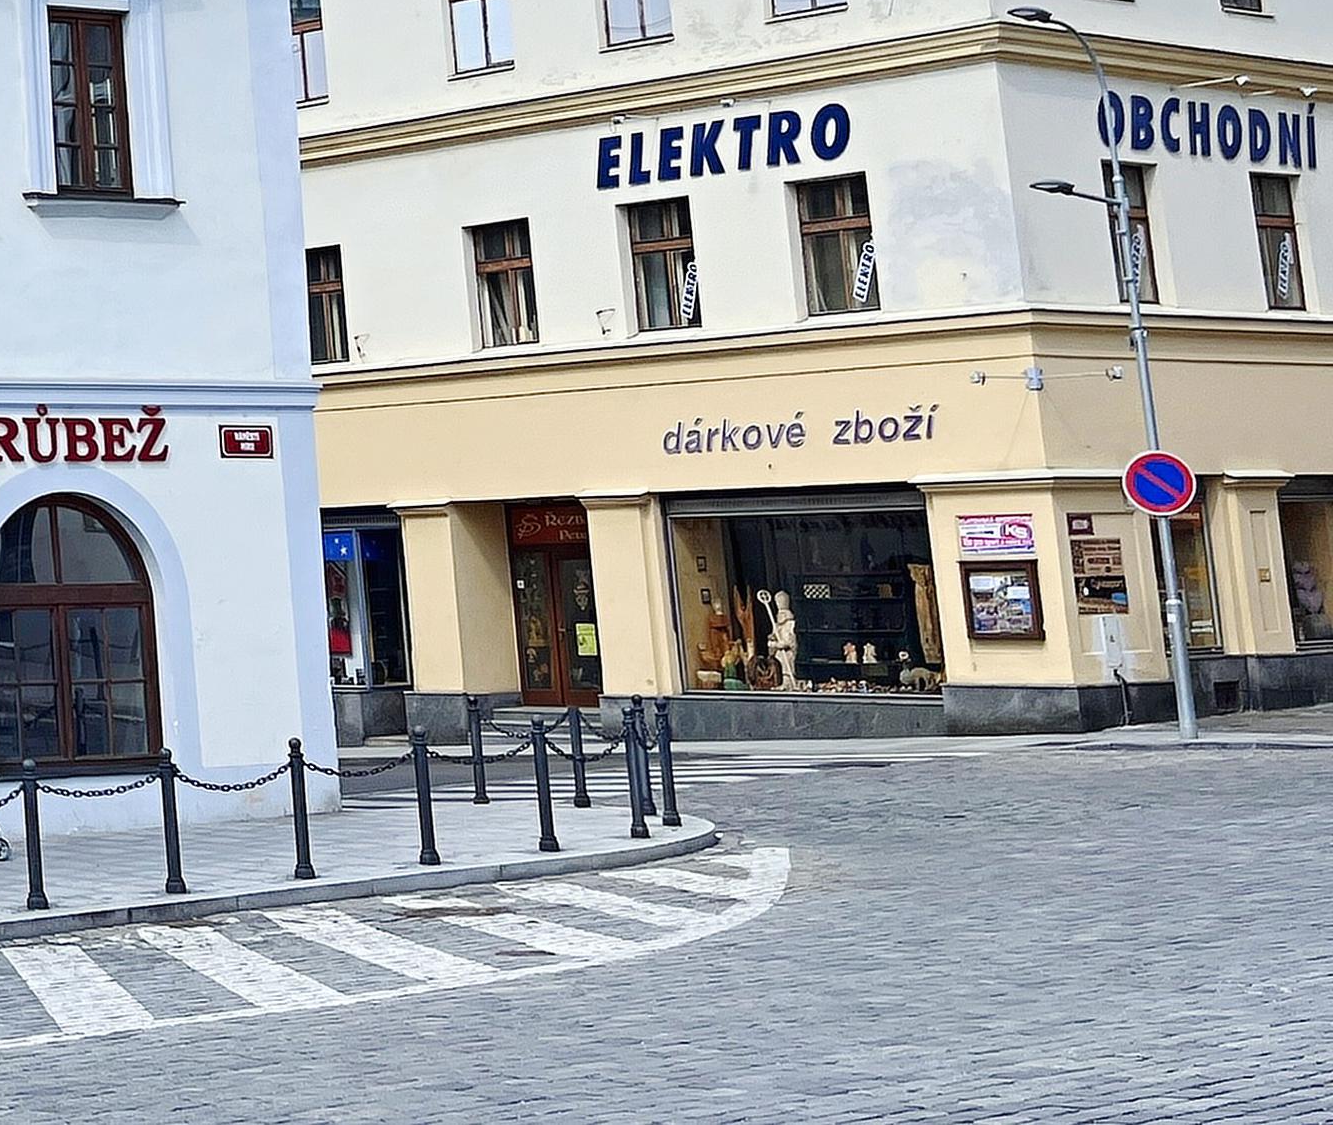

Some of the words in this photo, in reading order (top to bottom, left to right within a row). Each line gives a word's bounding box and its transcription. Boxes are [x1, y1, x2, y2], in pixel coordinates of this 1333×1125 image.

[597, 103, 851, 190] ELEKTRO
[1098, 90, 1317, 170] OBCHODNÍ
[854, 243, 875, 300] ELEKTRO
[662, 411, 806, 455] dárkové
[832, 404, 940, 445] zboží
